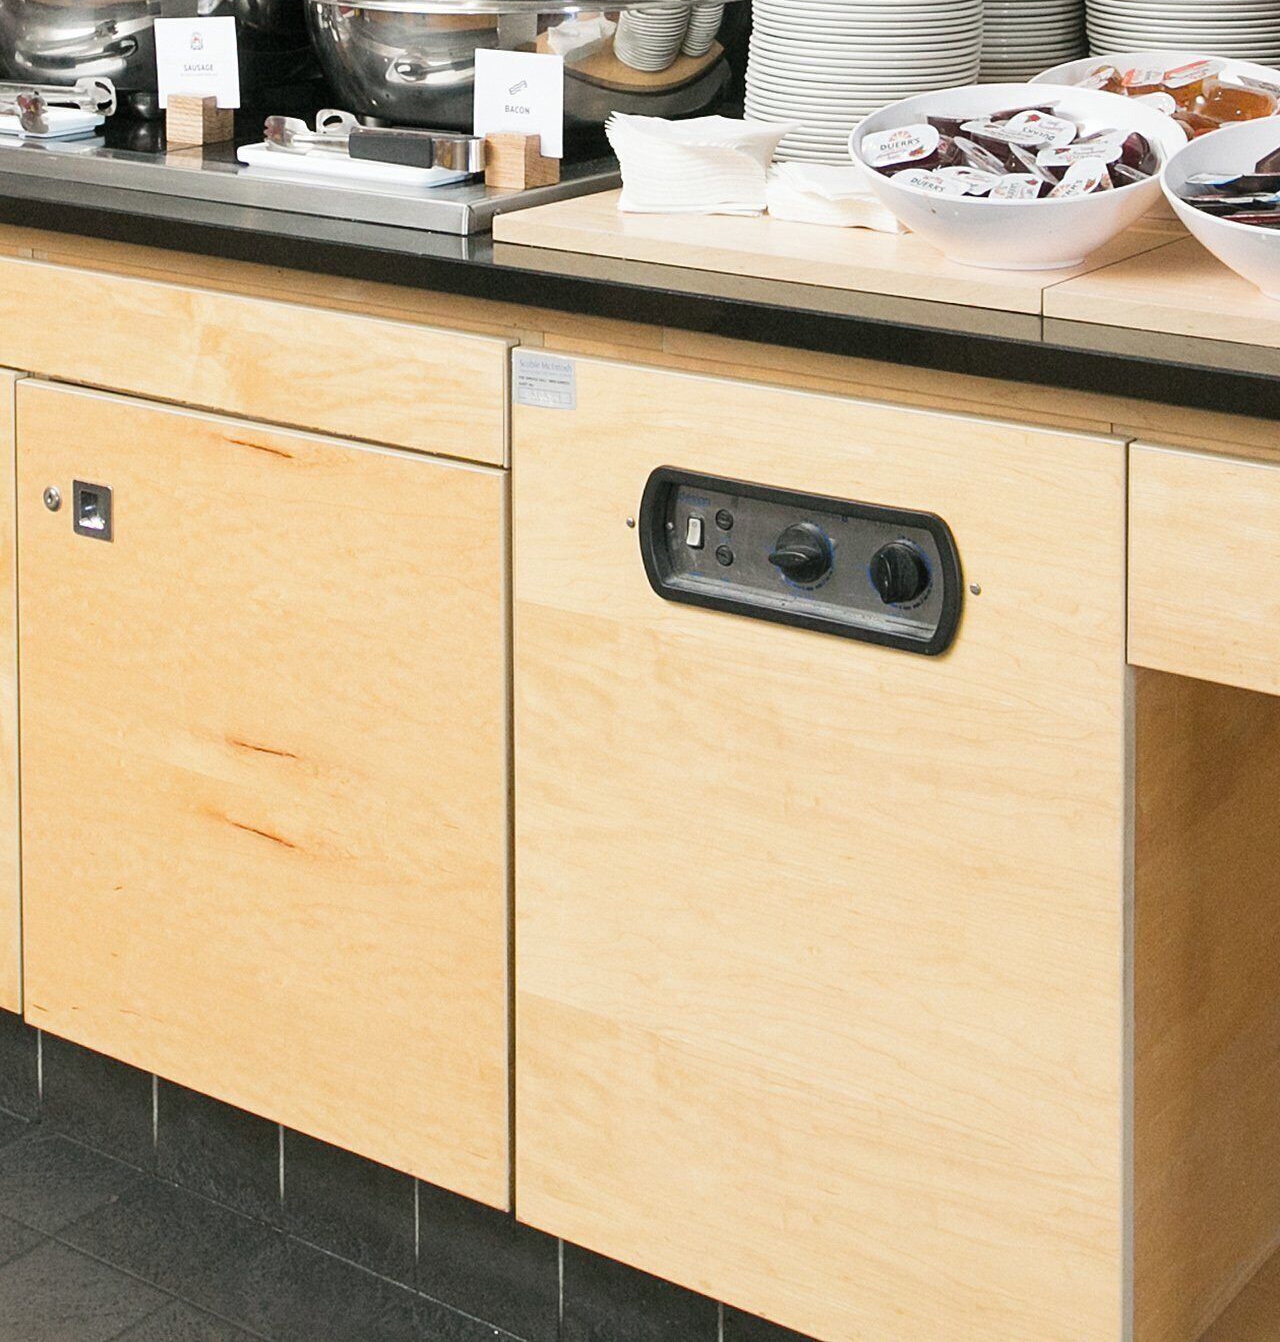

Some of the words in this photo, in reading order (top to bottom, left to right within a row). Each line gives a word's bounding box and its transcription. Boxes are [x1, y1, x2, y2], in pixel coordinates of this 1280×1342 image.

[184, 64, 214, 72] SAUSAGE
[504, 105, 530, 115] BACON
[880, 138, 920, 151] DUERR'S
